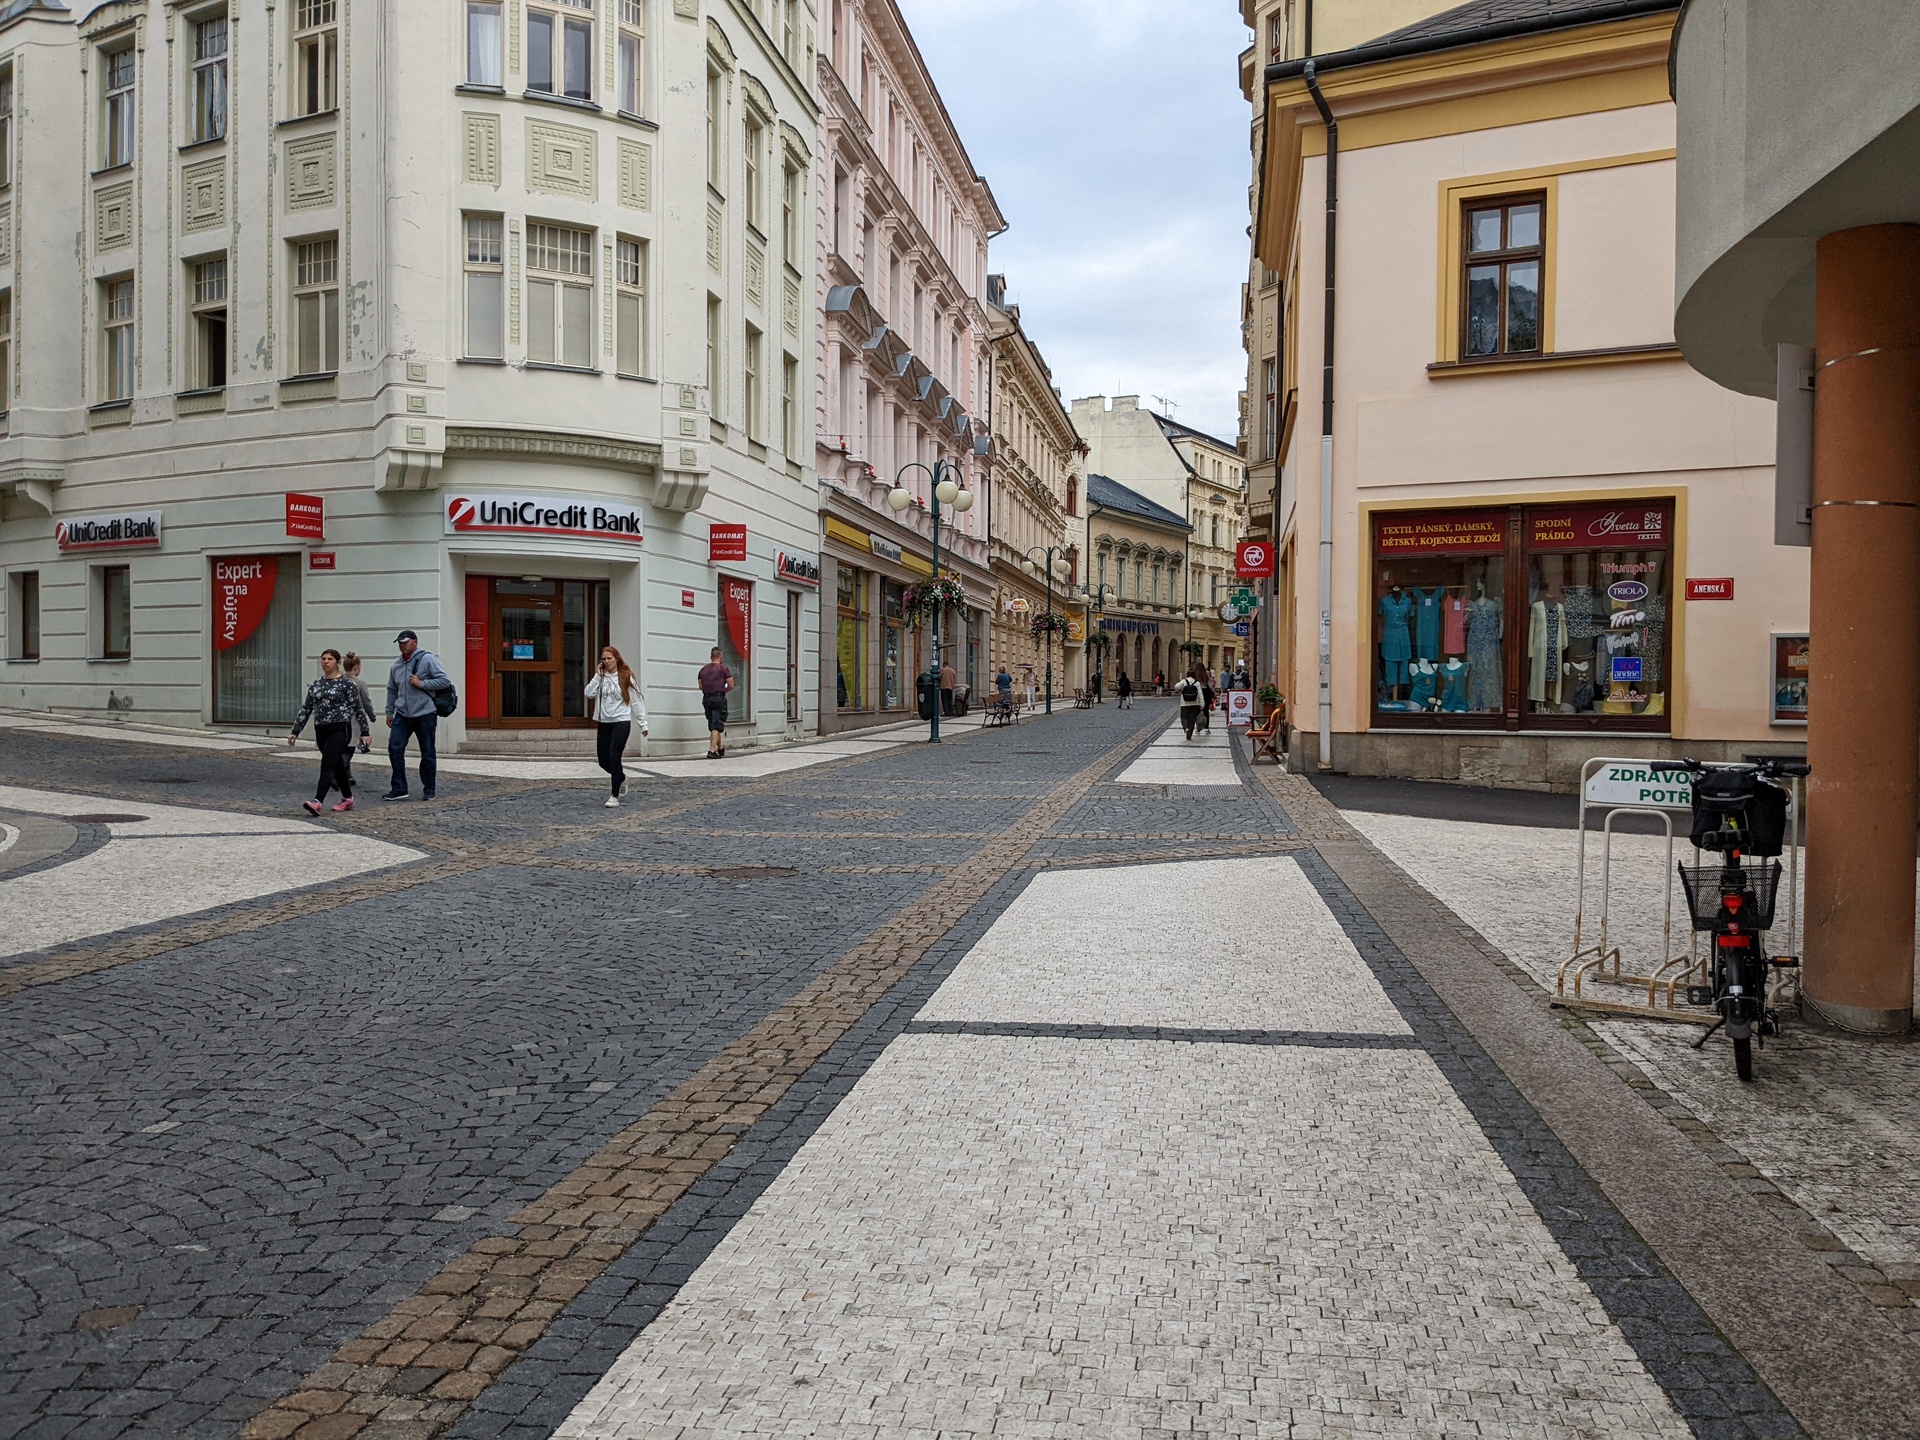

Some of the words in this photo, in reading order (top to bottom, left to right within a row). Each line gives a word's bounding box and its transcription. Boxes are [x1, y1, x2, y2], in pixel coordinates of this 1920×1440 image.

[290, 503, 321, 514] BANKOMAT
[480, 500, 587, 528] UniCredit
[593, 507, 641, 534] Bank
[1535, 517, 1572, 528] SPODNÍ
[69, 519, 122, 542] UniCredit
[124, 517, 156, 539] Bank
[1382, 526, 1414, 535] TEXTIL
[1415, 523, 1453, 533] PÁNSKÝ,
[1454, 521, 1495, 532] DÁMSKÝ,
[1588, 512, 1639, 537] Yvetta
[711, 532, 744, 540] BANKOMAT
[1382, 536, 1418, 547] DĚTSKÝ,
[1420, 534, 1472, 547] KOJENECKÉ
[1473, 532, 1501, 543] ZBOŽÍ
[1535, 530, 1575, 541] PRÁDLO
[216, 561, 262, 583] Expert
[785, 554, 807, 578] UniCredit
[1600, 561, 1647, 575] Triumph
[235, 584, 248, 595] na
[730, 583, 749, 602] Expert
[1613, 587, 1644, 595] TRIOLA
[1693, 583, 1725, 593] ANENSKÁ
[223, 585, 238, 641] půjčky
[738, 602, 745, 612] na
[1608, 768, 1697, 785] ZDRAVO
